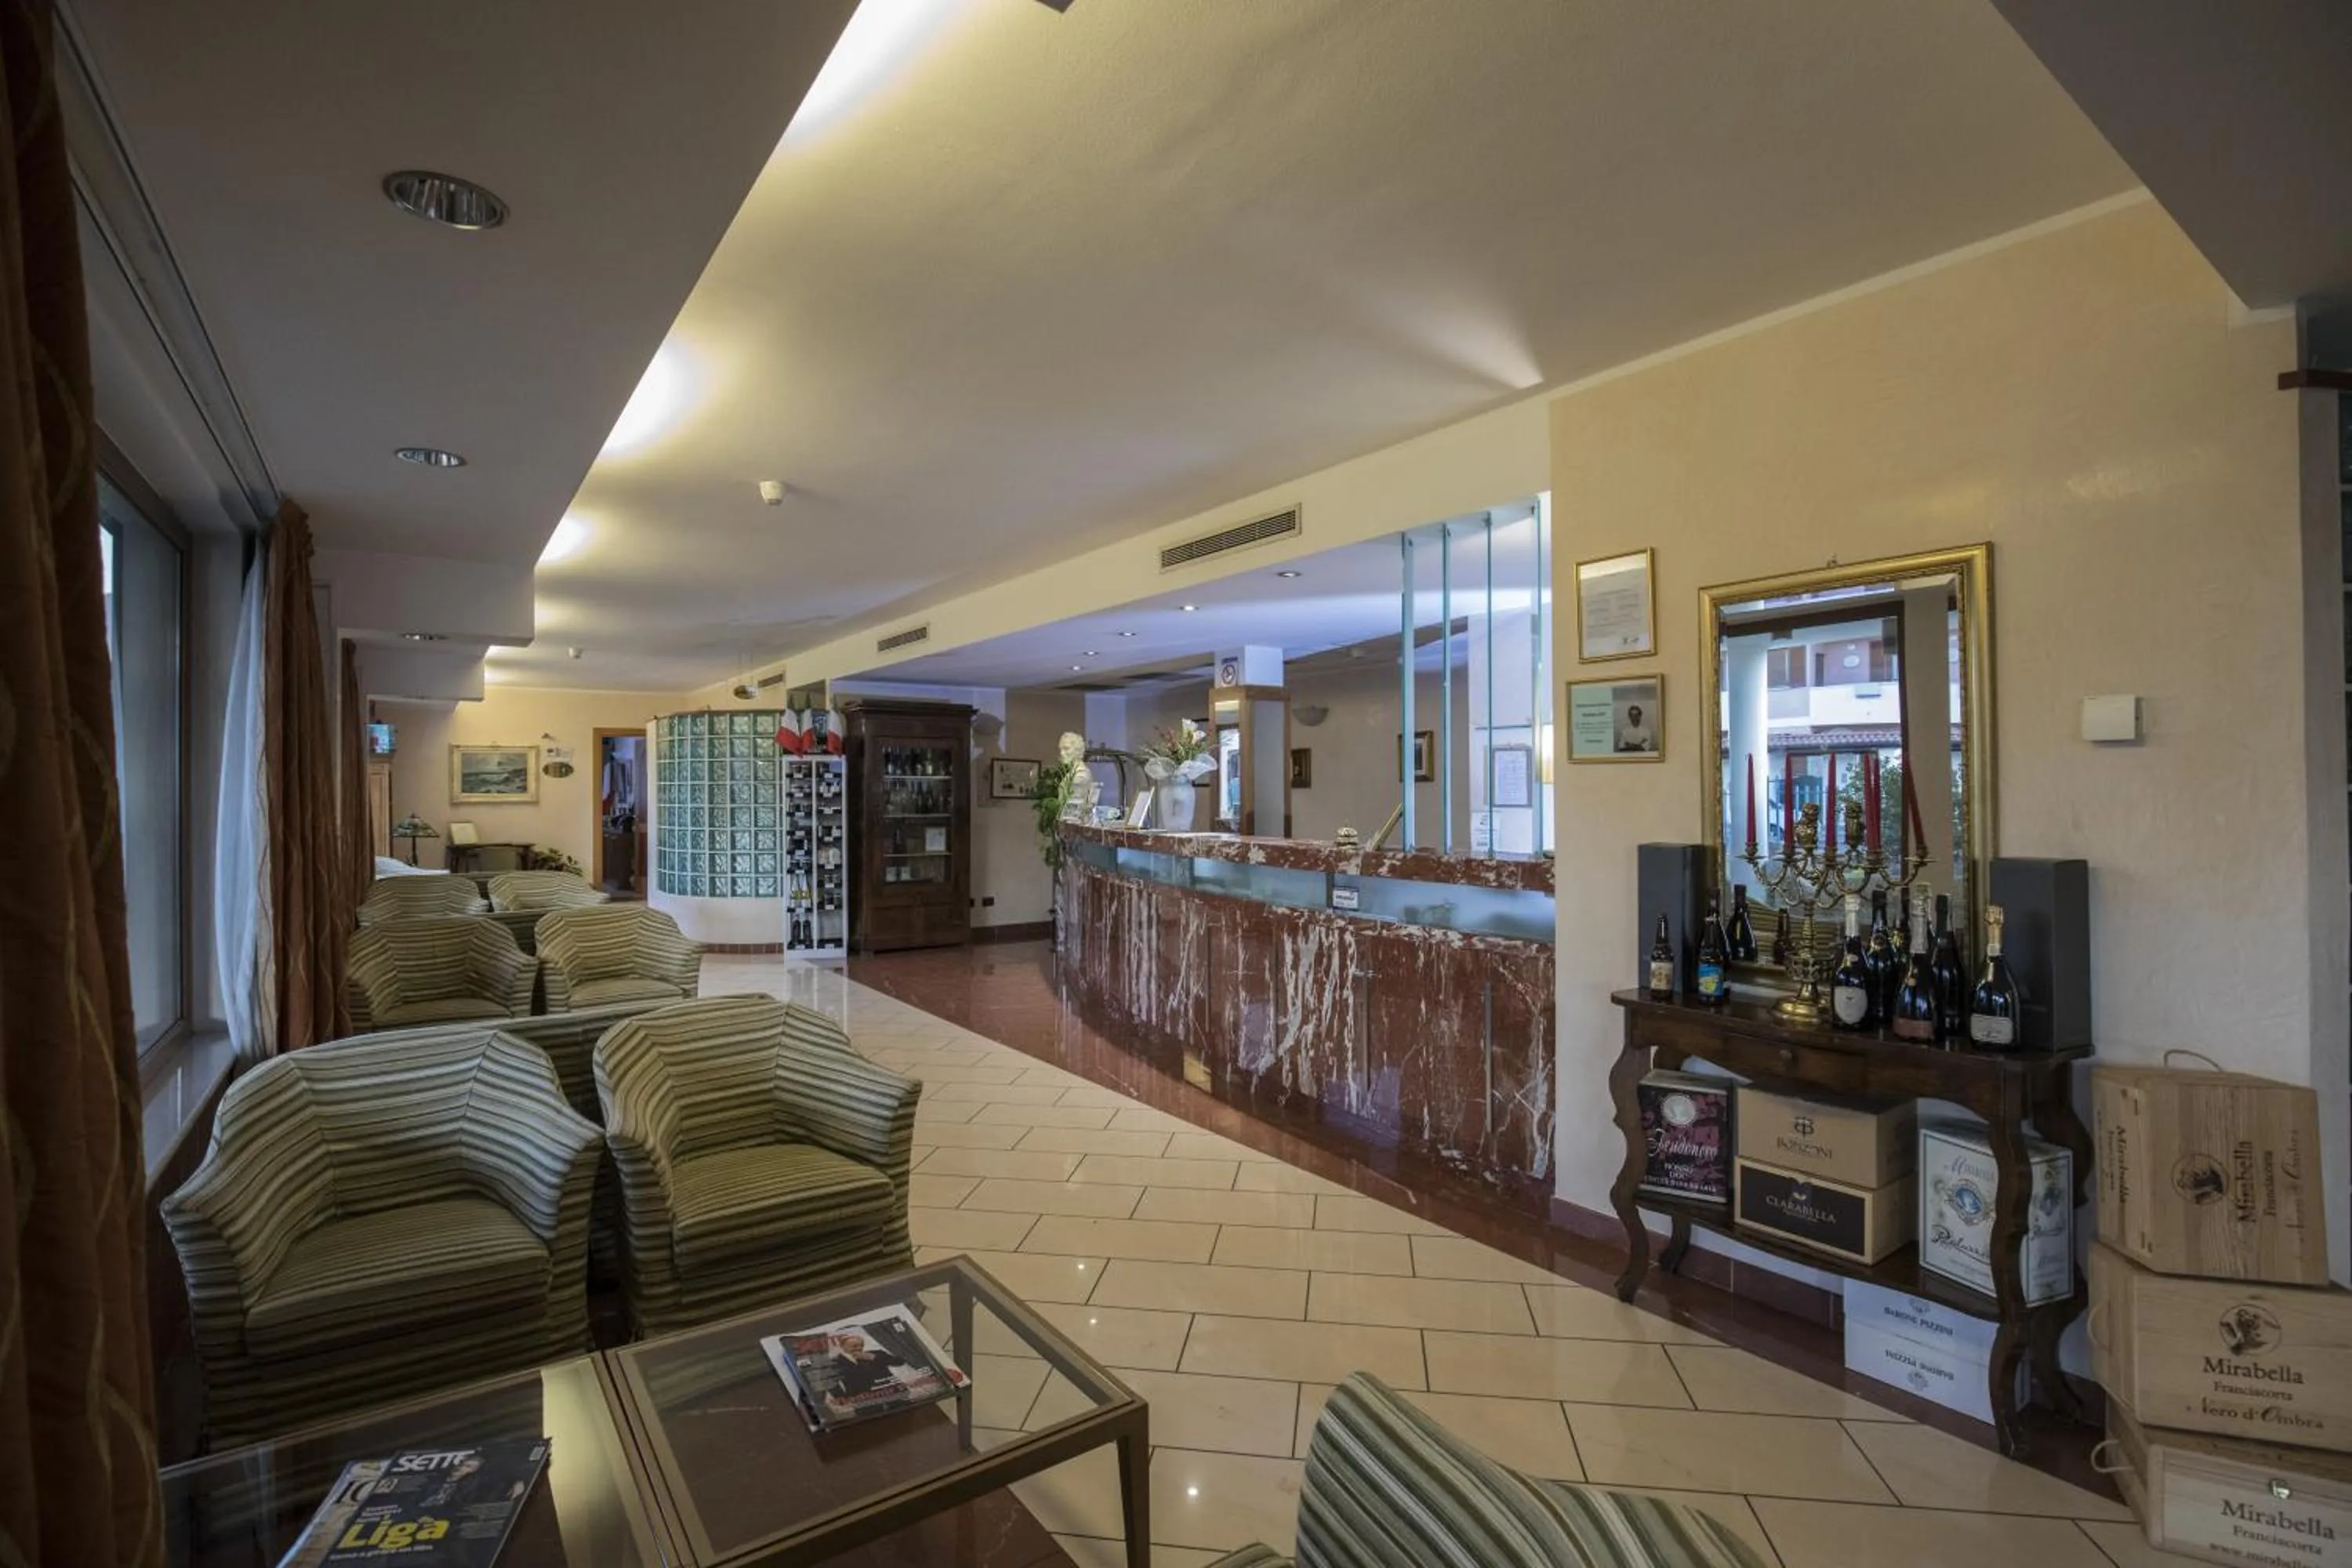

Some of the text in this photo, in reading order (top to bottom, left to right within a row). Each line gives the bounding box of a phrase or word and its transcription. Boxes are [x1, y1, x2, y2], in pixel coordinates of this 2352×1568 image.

[2233, 1141, 2256, 1223] Mirabella
[1766, 1194, 1838, 1225] CLARABELLA
[2202, 1356, 2304, 1385] Mirabella
[2213, 1381, 2294, 1401] Franciacorta
[336, 1515, 451, 1550] Liga
[2220, 1499, 2336, 1541] Mirabella
[2232, 1525, 2322, 1555] Franciacorta
